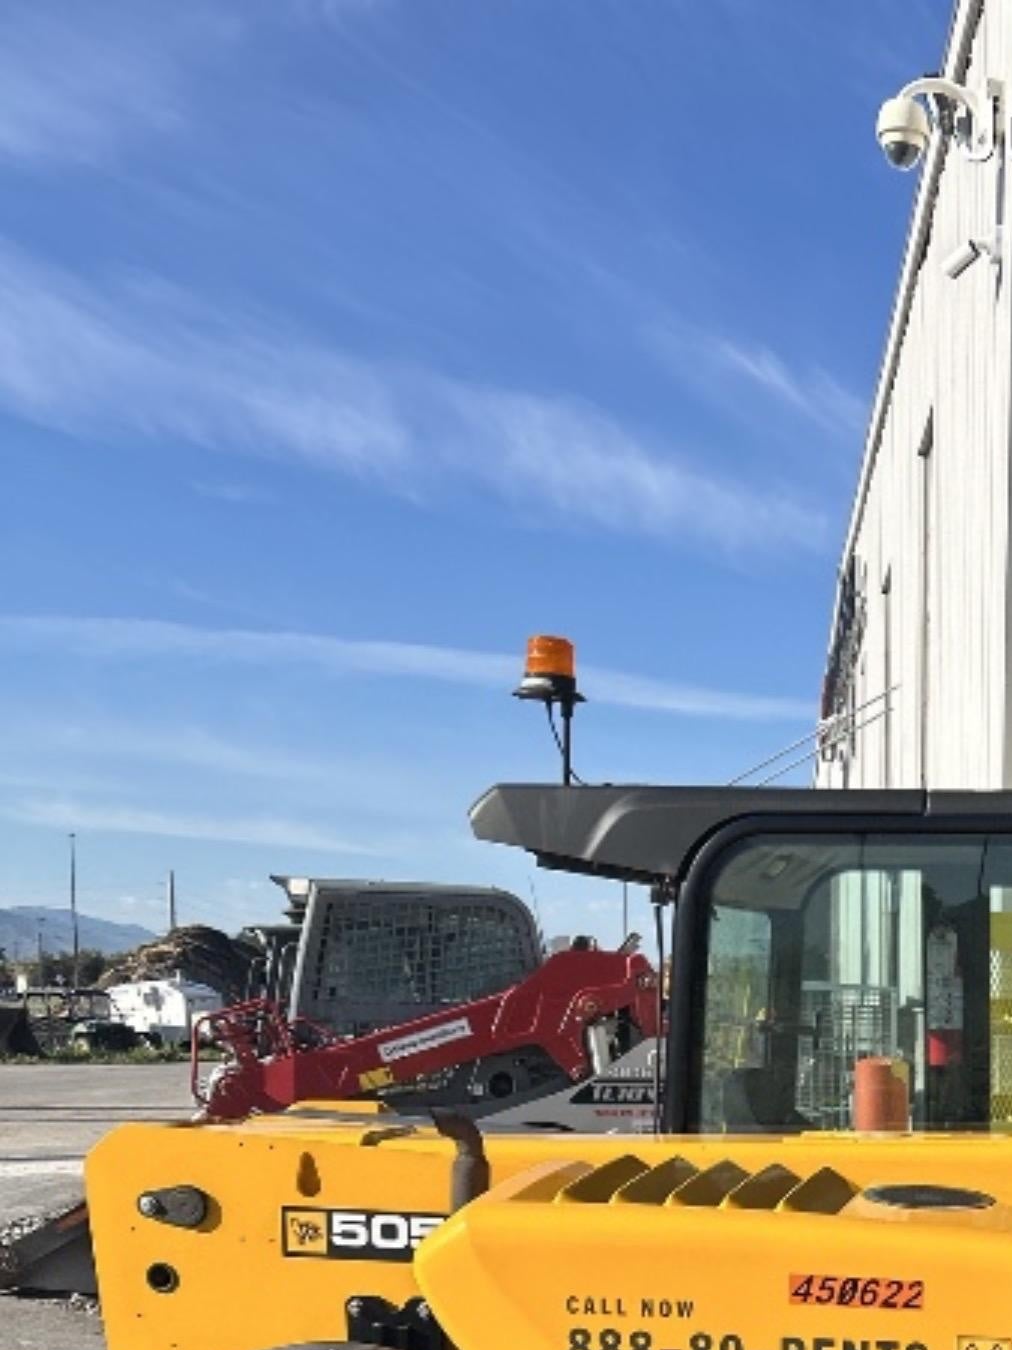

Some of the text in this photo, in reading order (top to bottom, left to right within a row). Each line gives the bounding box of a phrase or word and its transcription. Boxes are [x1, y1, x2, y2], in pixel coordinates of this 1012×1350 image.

[791, 1274, 924, 1309] 450622
[566, 1295, 695, 1318] CALL NOW
